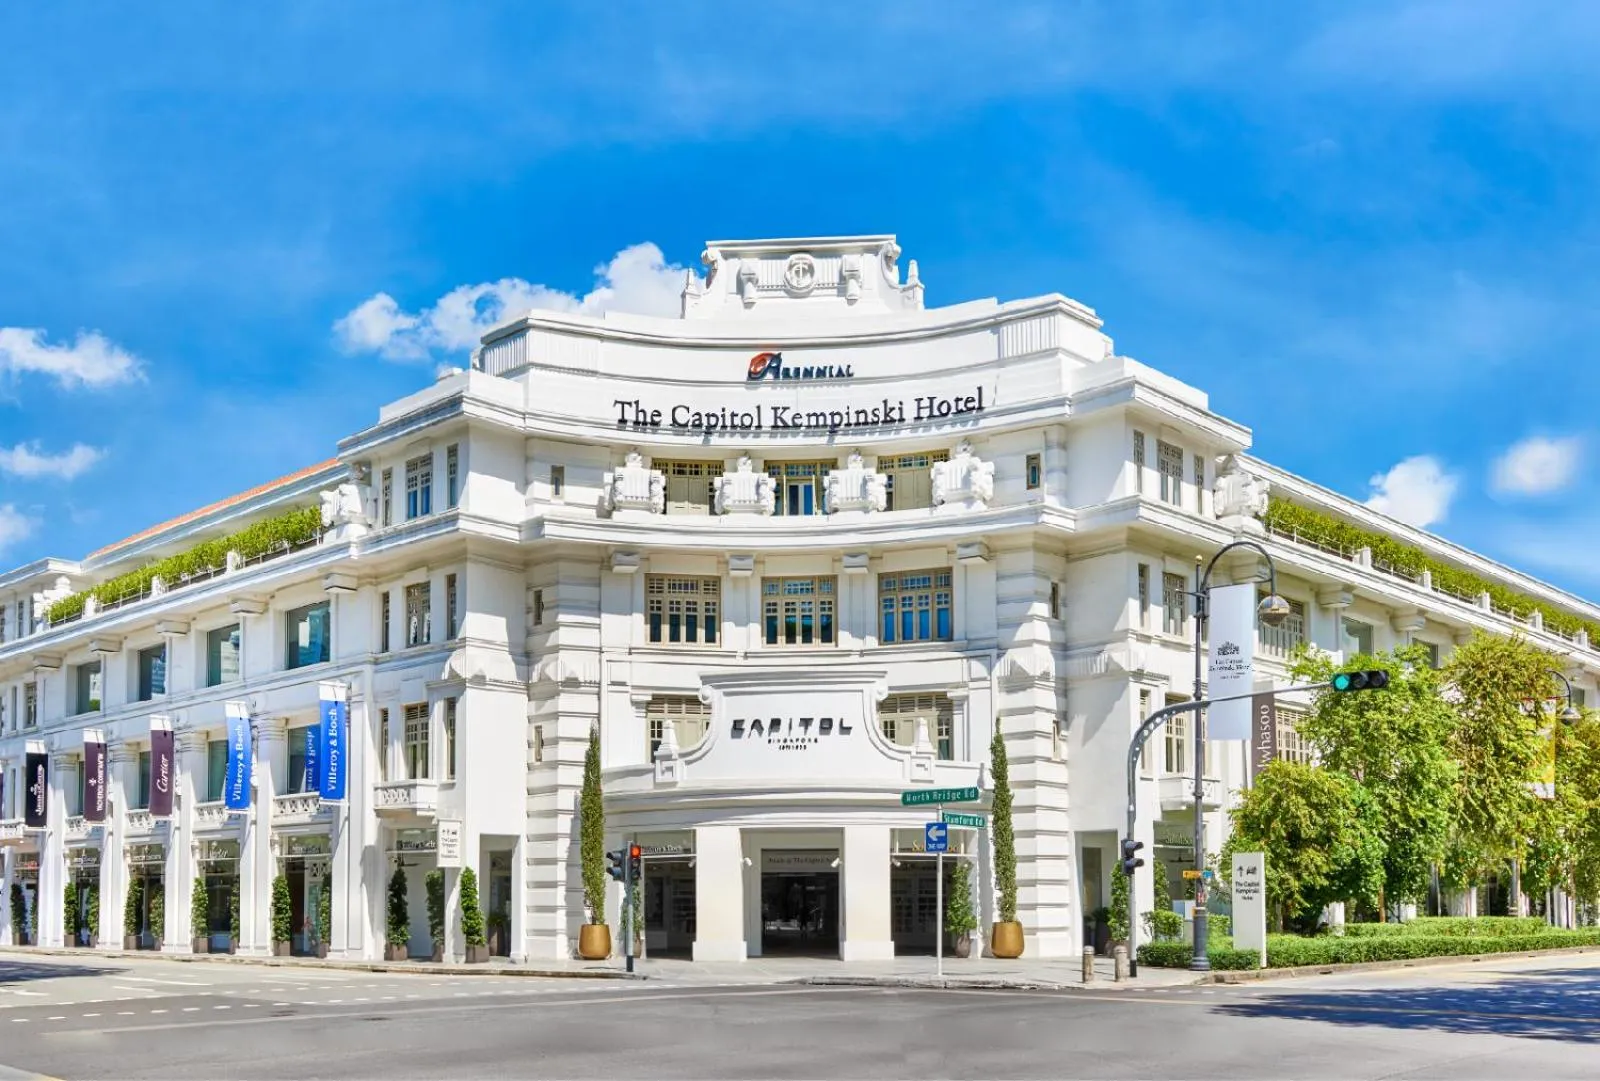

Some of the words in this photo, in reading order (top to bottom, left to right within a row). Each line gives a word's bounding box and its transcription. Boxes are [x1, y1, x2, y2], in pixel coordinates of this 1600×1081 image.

[613, 400, 662, 426] The
[670, 404, 762, 434] Capitol
[770, 399, 905, 433] Kempinski
[914, 386, 985, 420] Hotel
[234, 724, 244, 751] Boch
[328, 708, 338, 738] Boch
[731, 717, 853, 738] CAPITOL
[1257, 704, 1272, 770] lwhasoo
[156, 753, 169, 793] Cartier
[232, 760, 246, 801] Villeroy
[327, 750, 340, 791] Villeroy
[906, 794, 930, 802] North
[932, 789, 961, 800] Bridge
[964, 787, 975, 798] Rd
[943, 814, 974, 826] Stamford
